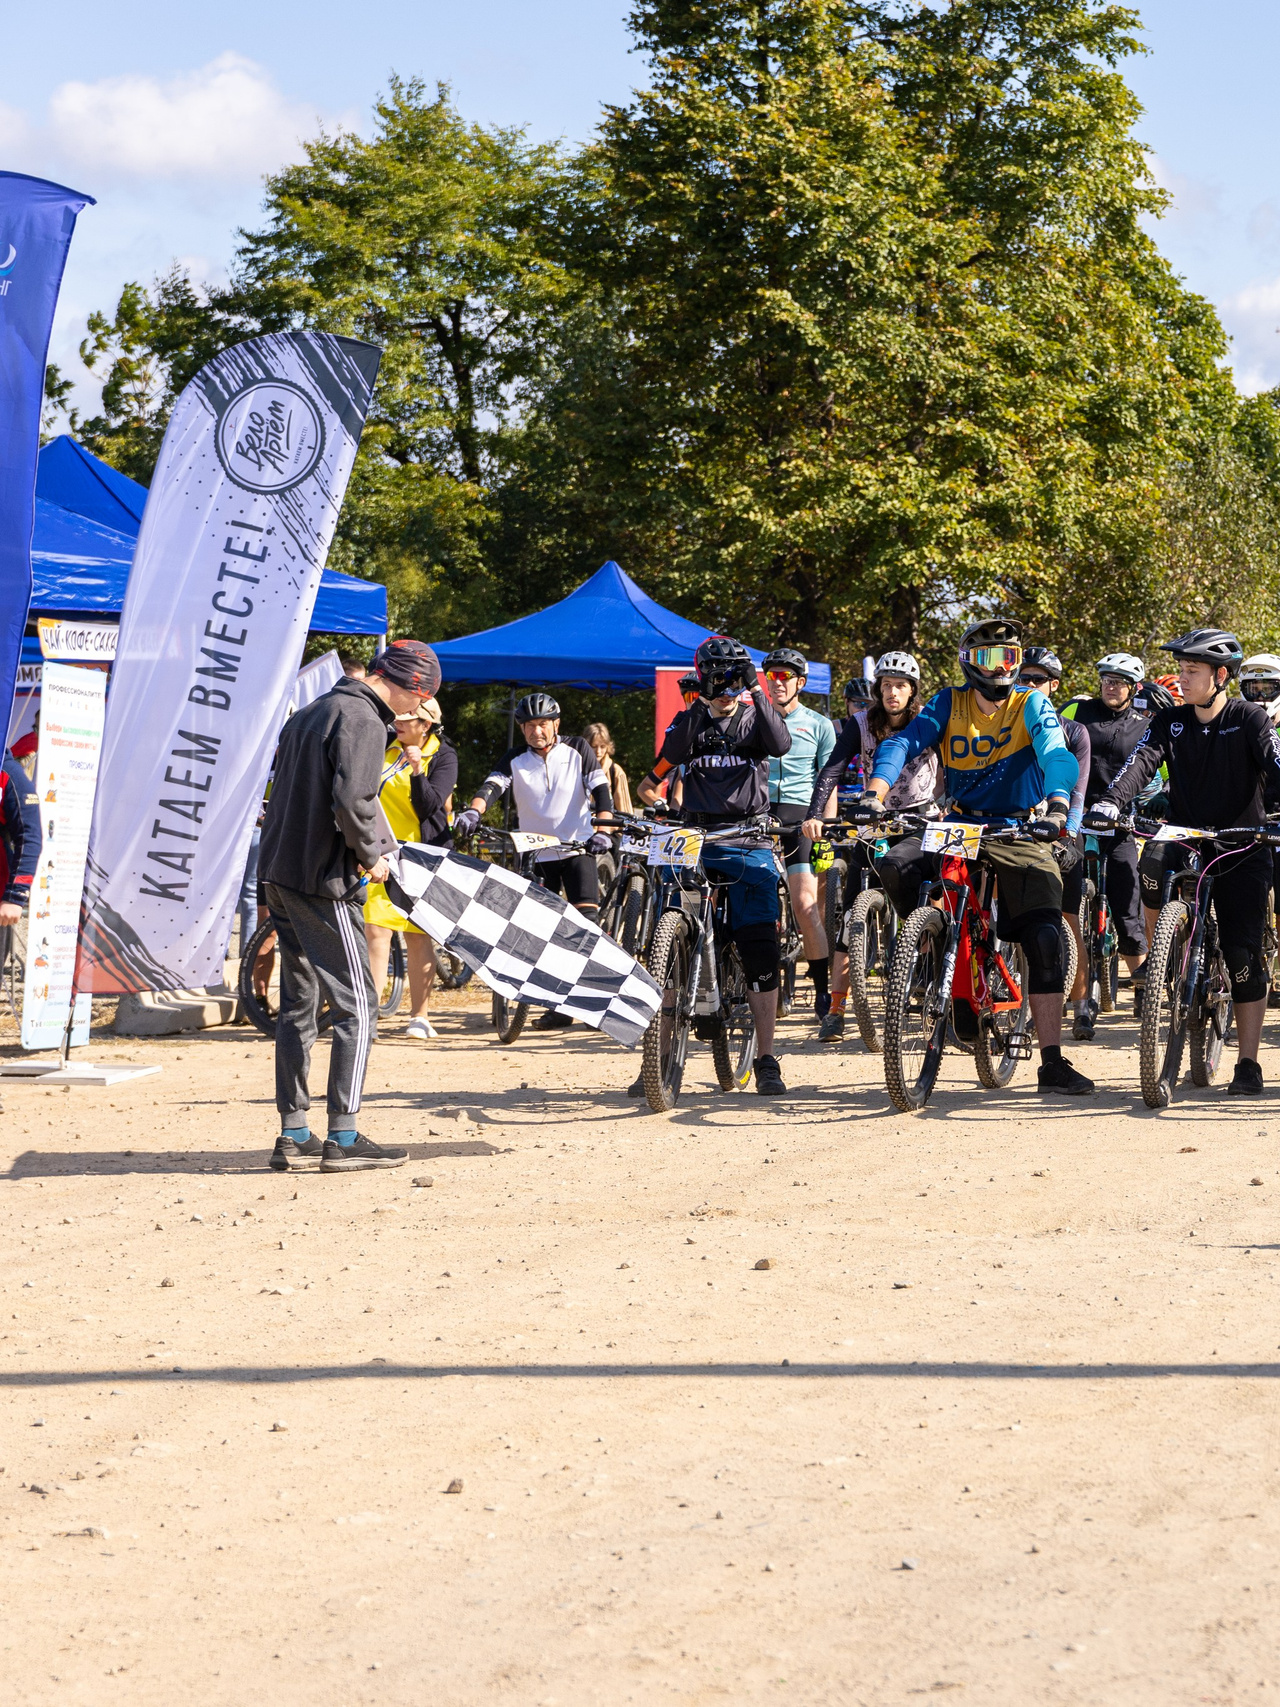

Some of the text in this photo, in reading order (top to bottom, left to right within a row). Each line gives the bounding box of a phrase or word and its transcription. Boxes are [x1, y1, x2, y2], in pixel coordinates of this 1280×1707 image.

[260, 400, 289, 475] Артём
[139, 519, 273, 903] КАТАЕМ ВМЕСТЕ!
[526, 834, 545, 844] 56
[663, 836, 686, 856] 42
[943, 827, 965, 847] 13
